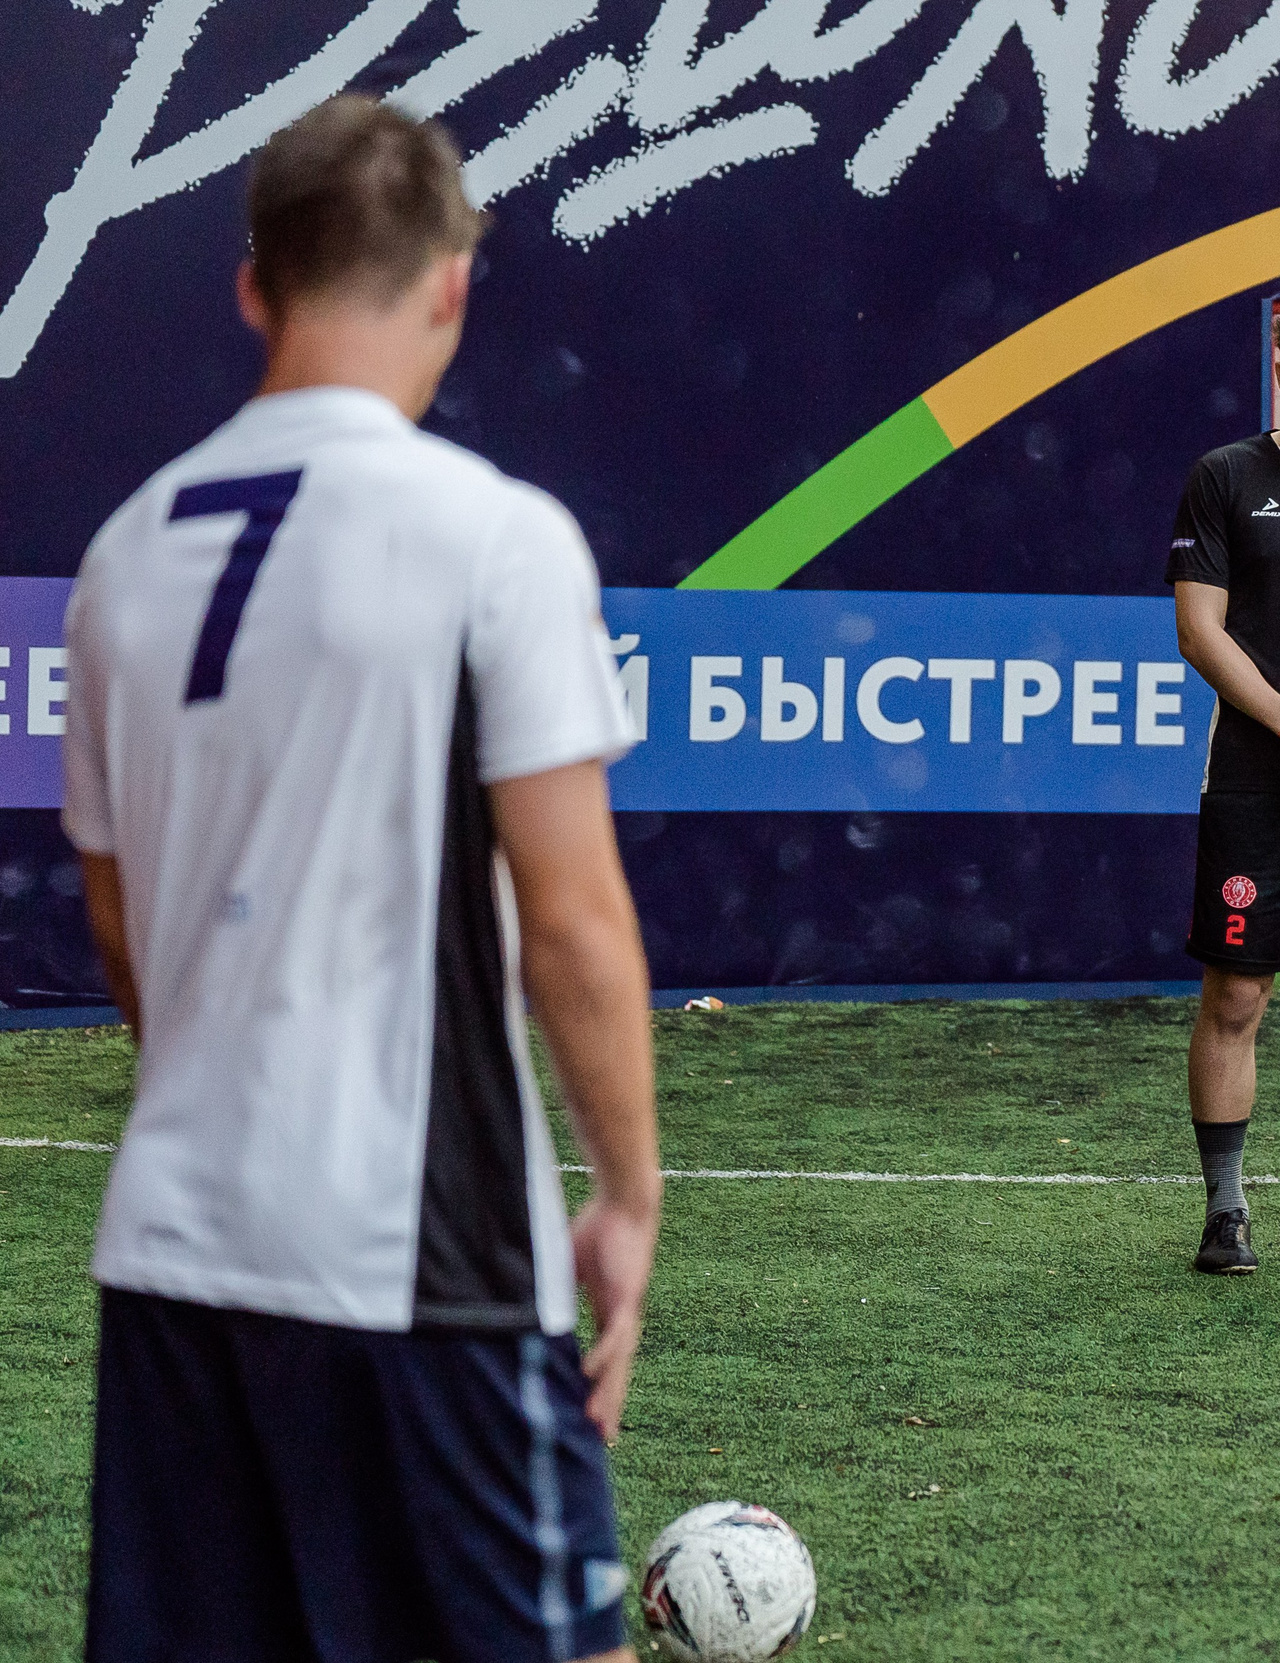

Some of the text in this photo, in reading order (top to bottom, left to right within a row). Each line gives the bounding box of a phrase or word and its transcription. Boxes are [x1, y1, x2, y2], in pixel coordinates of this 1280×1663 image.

[168, 468, 303, 705] 7
[0, 647, 67, 735] Е
[690, 655, 1186, 746] БЫСТРЕЕ
[1226, 915, 1246, 945] 2
